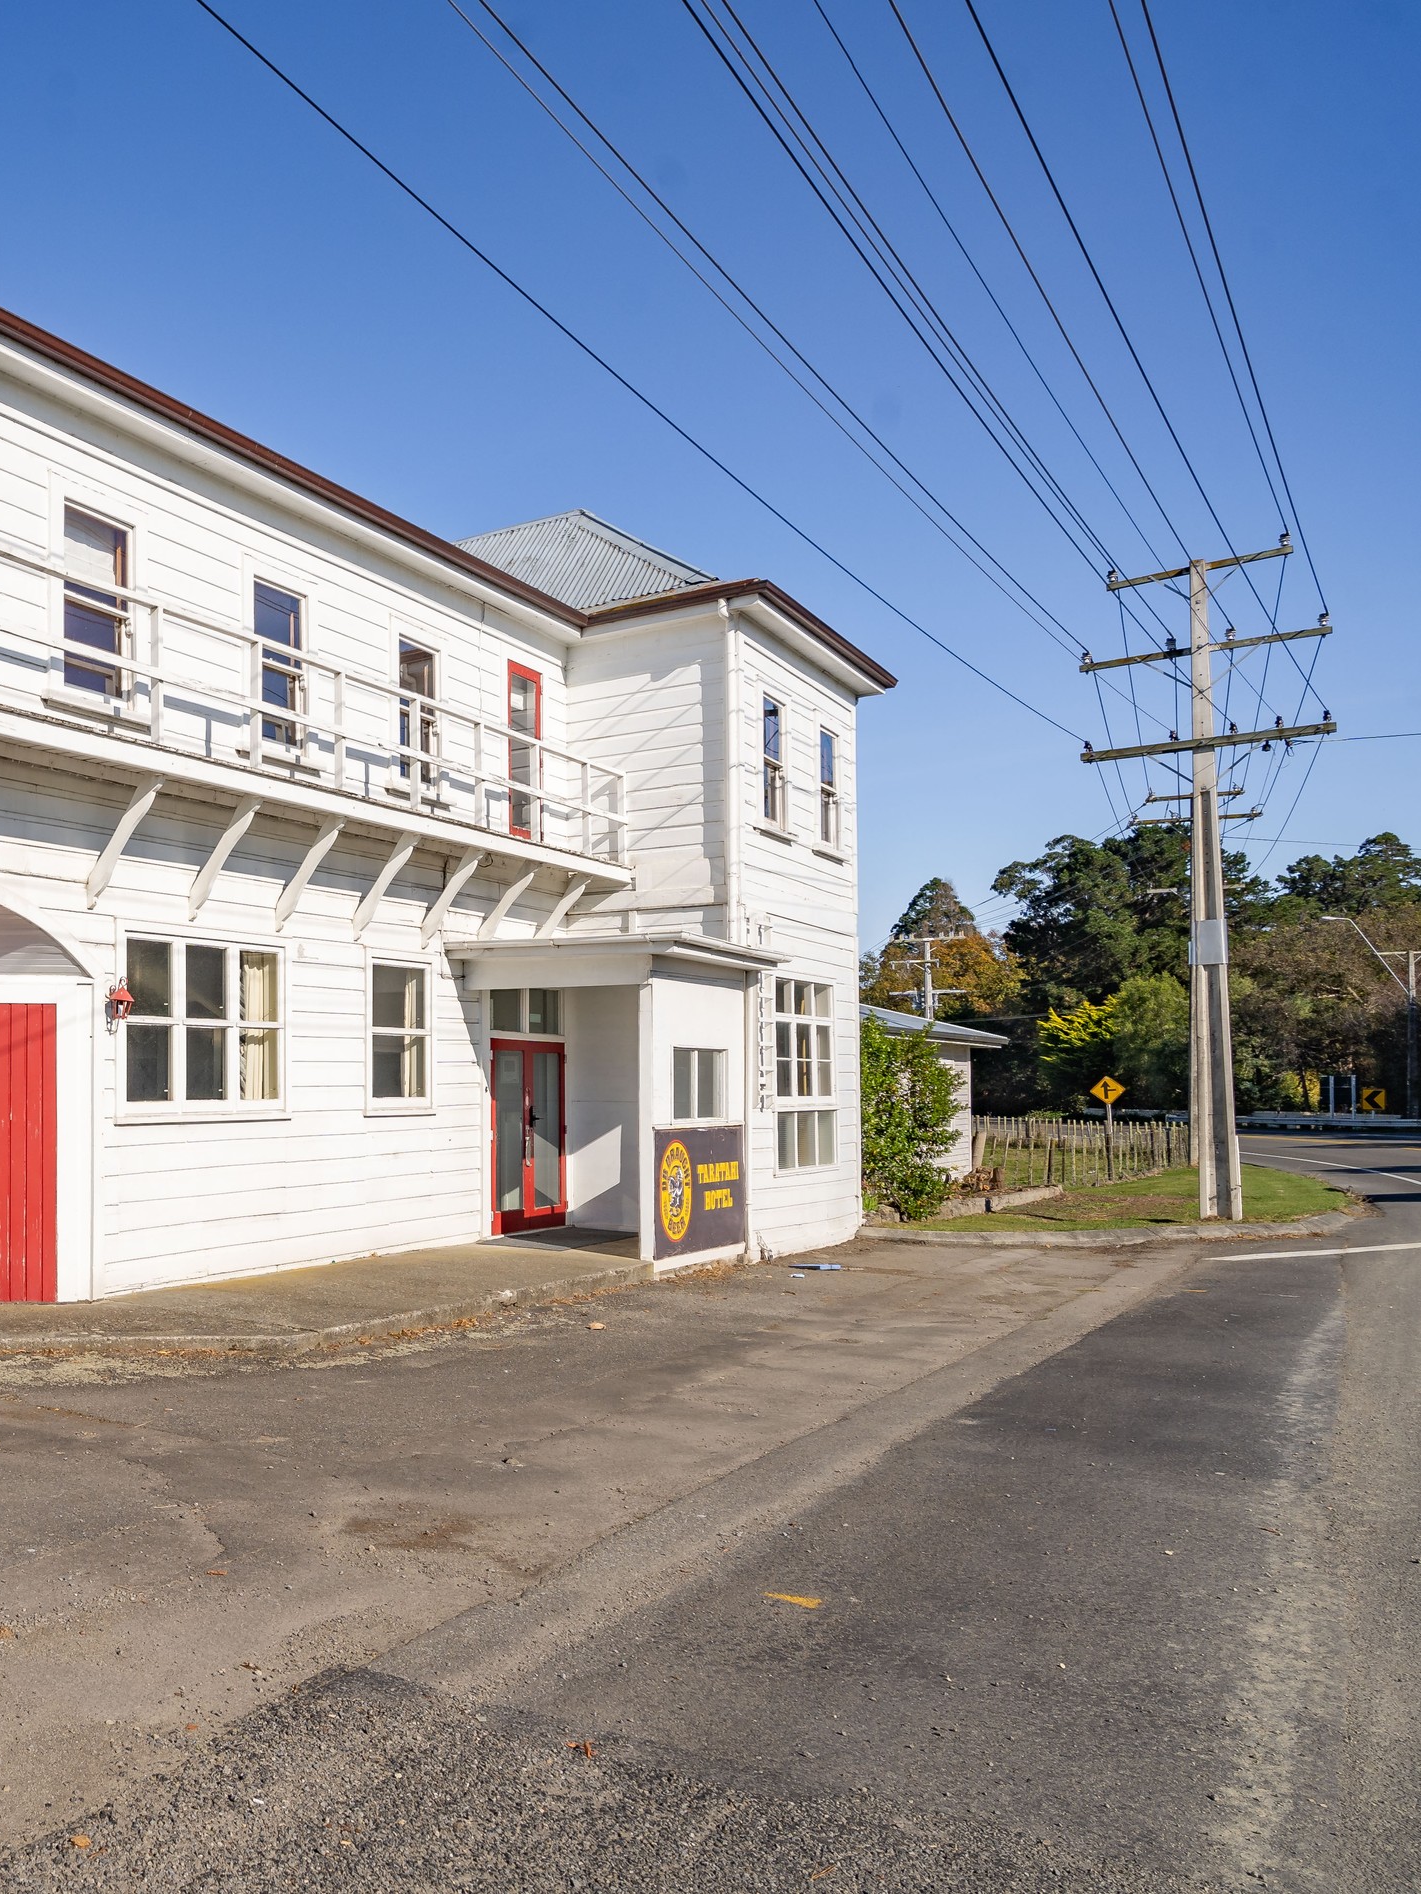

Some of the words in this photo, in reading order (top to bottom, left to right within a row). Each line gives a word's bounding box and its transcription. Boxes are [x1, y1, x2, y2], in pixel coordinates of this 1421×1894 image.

[697, 1161, 739, 1184] TARATAHI
[704, 1188, 733, 1211] HOTEL
[668, 1216, 686, 1234] BEER
